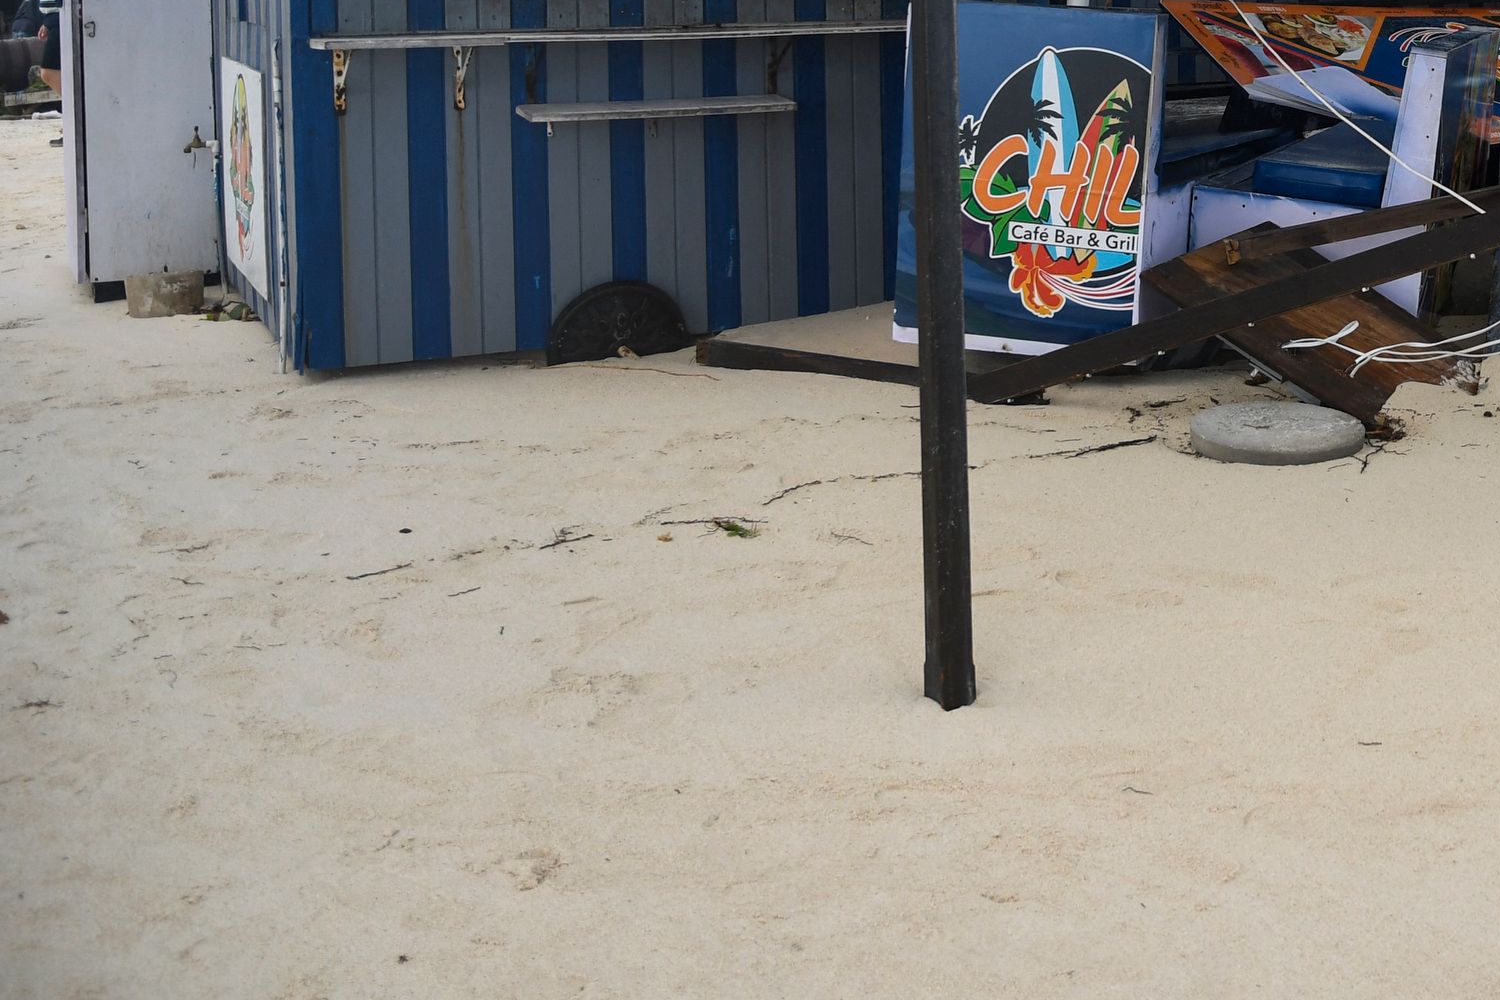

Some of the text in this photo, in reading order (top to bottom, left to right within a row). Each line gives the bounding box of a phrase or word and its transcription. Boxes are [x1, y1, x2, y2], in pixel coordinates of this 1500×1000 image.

[1011, 225, 1049, 242] Café
[1054, 229, 1082, 245] Bar
[1088, 233, 1100, 247] &
